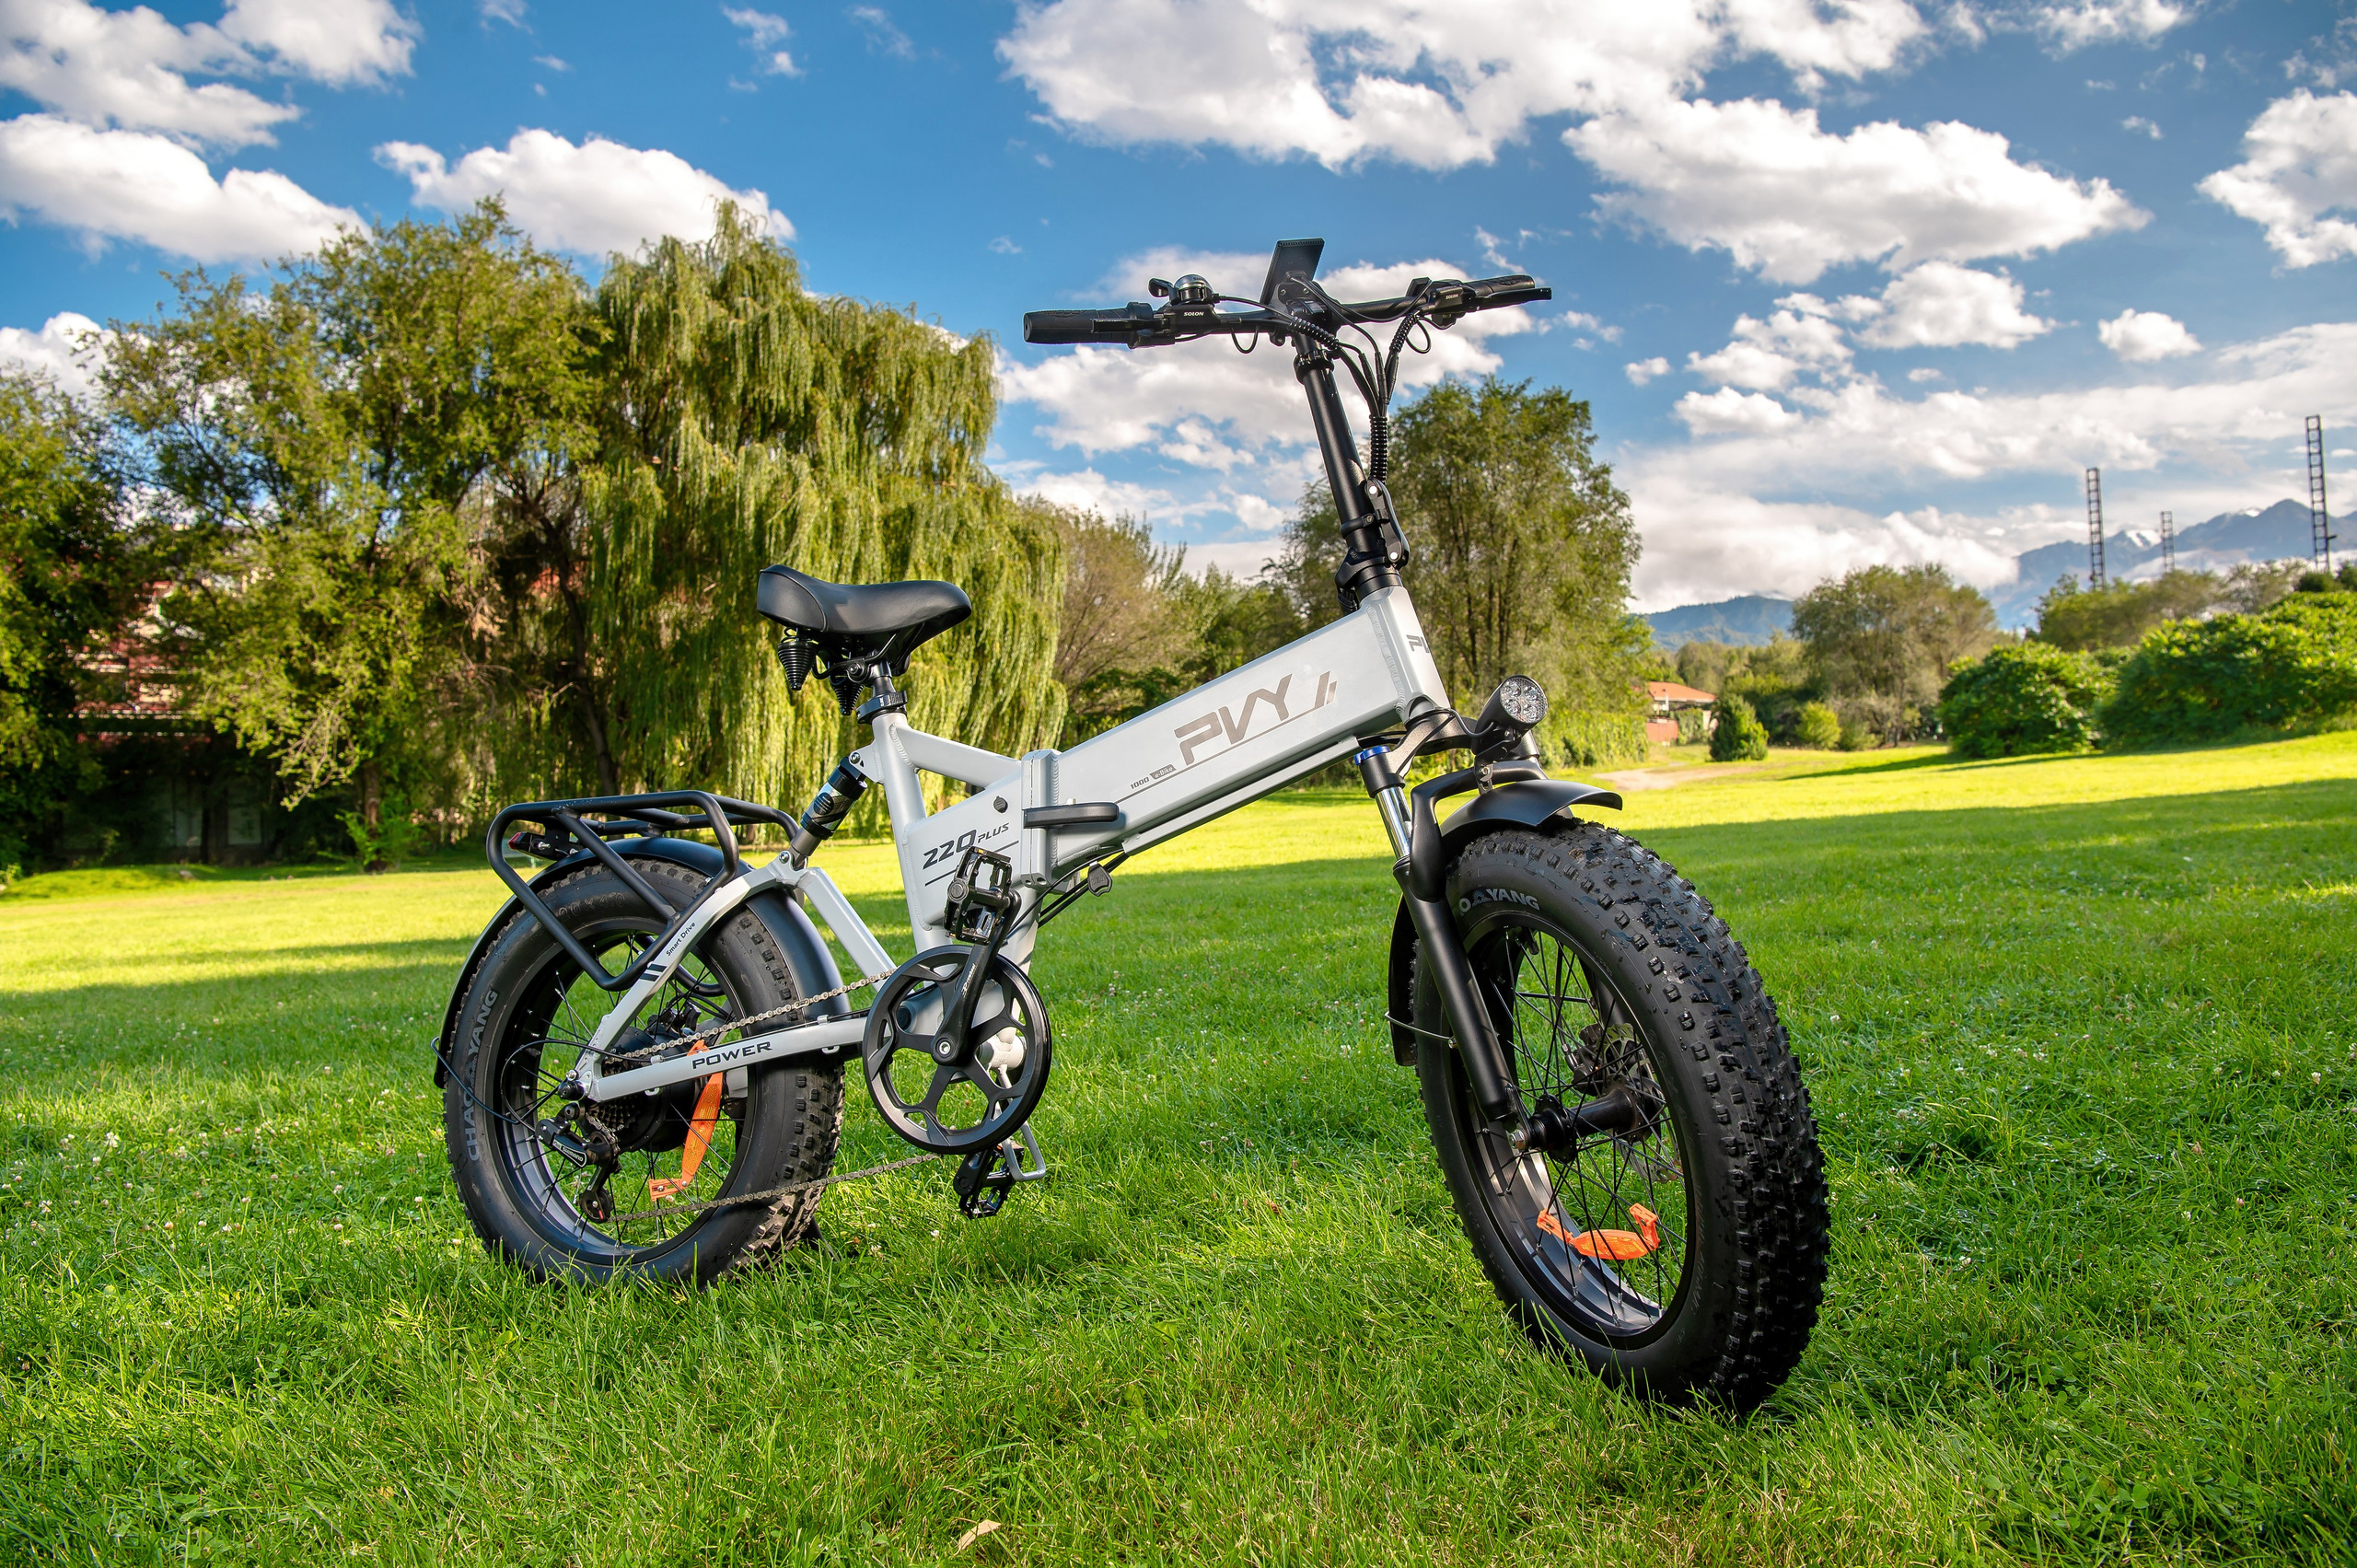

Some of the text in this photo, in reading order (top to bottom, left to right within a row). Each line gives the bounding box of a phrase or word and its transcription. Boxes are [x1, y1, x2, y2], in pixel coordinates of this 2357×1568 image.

[1174, 673, 1293, 766] PVY
[1130, 766, 1174, 789] 1000 e-Bike
[977, 822, 1010, 843] PLUS
[1485, 889, 1540, 911] YANG
[666, 922, 696, 957] Smart Drive
[692, 1041, 773, 1069] POWER
[463, 987, 499, 1162] CHAO YANG
